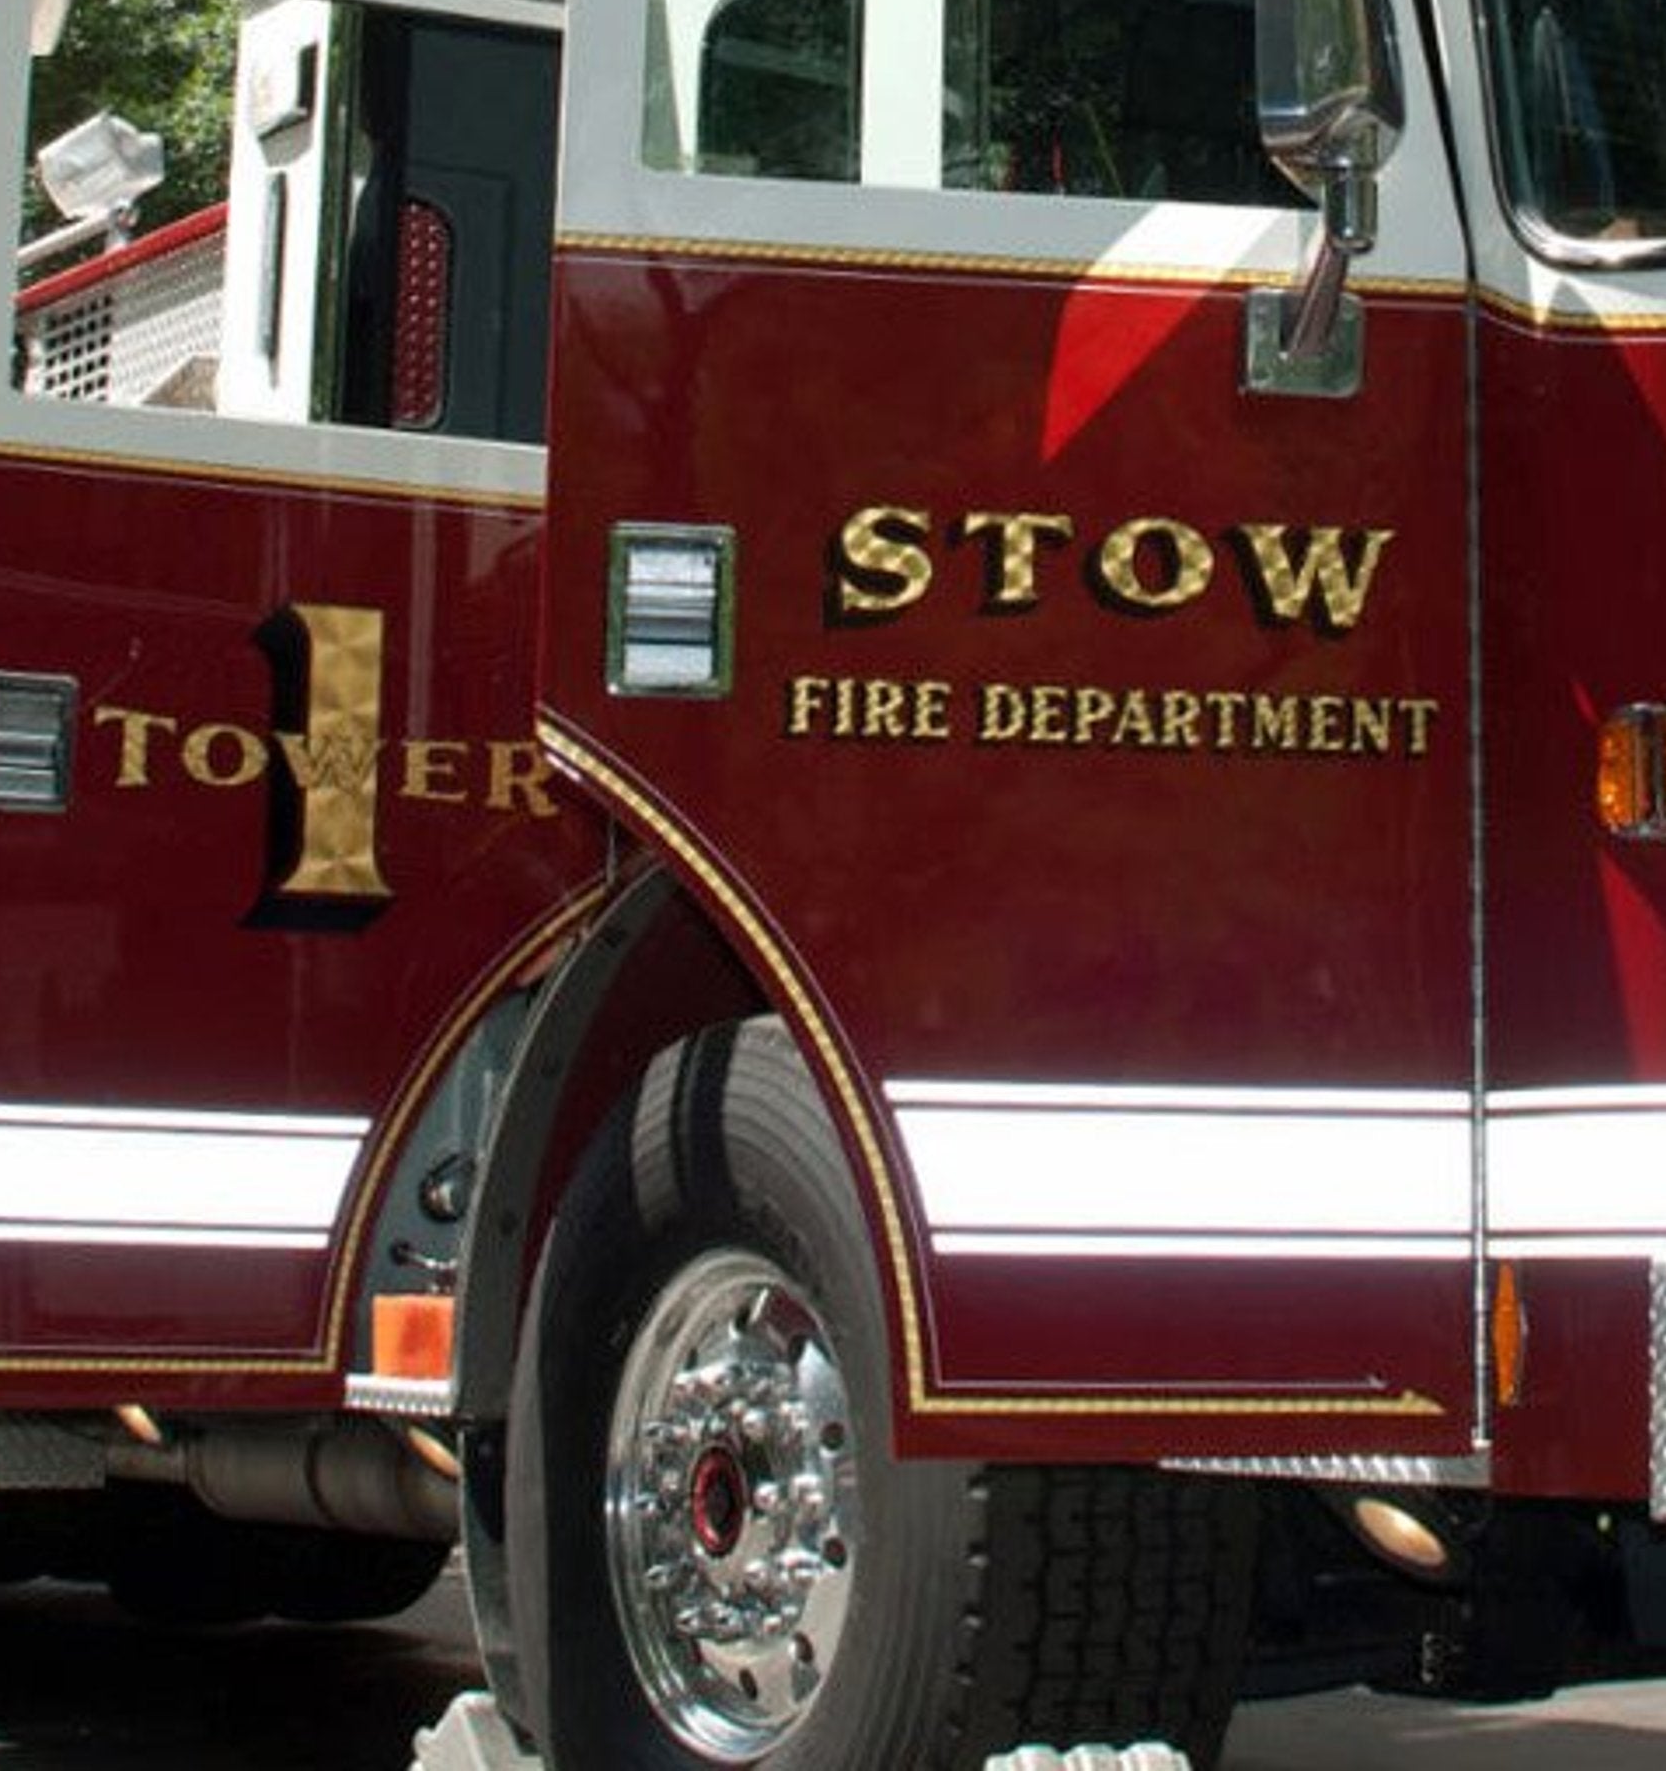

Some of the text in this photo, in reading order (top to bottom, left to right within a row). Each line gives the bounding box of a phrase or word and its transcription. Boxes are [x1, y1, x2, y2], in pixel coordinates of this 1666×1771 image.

[838, 506, 1395, 628] STOW
[93, 706, 560, 817] TOWER
[278, 602, 394, 896] 1
[787, 674, 1439, 754] FIRE DEPARTMENT
